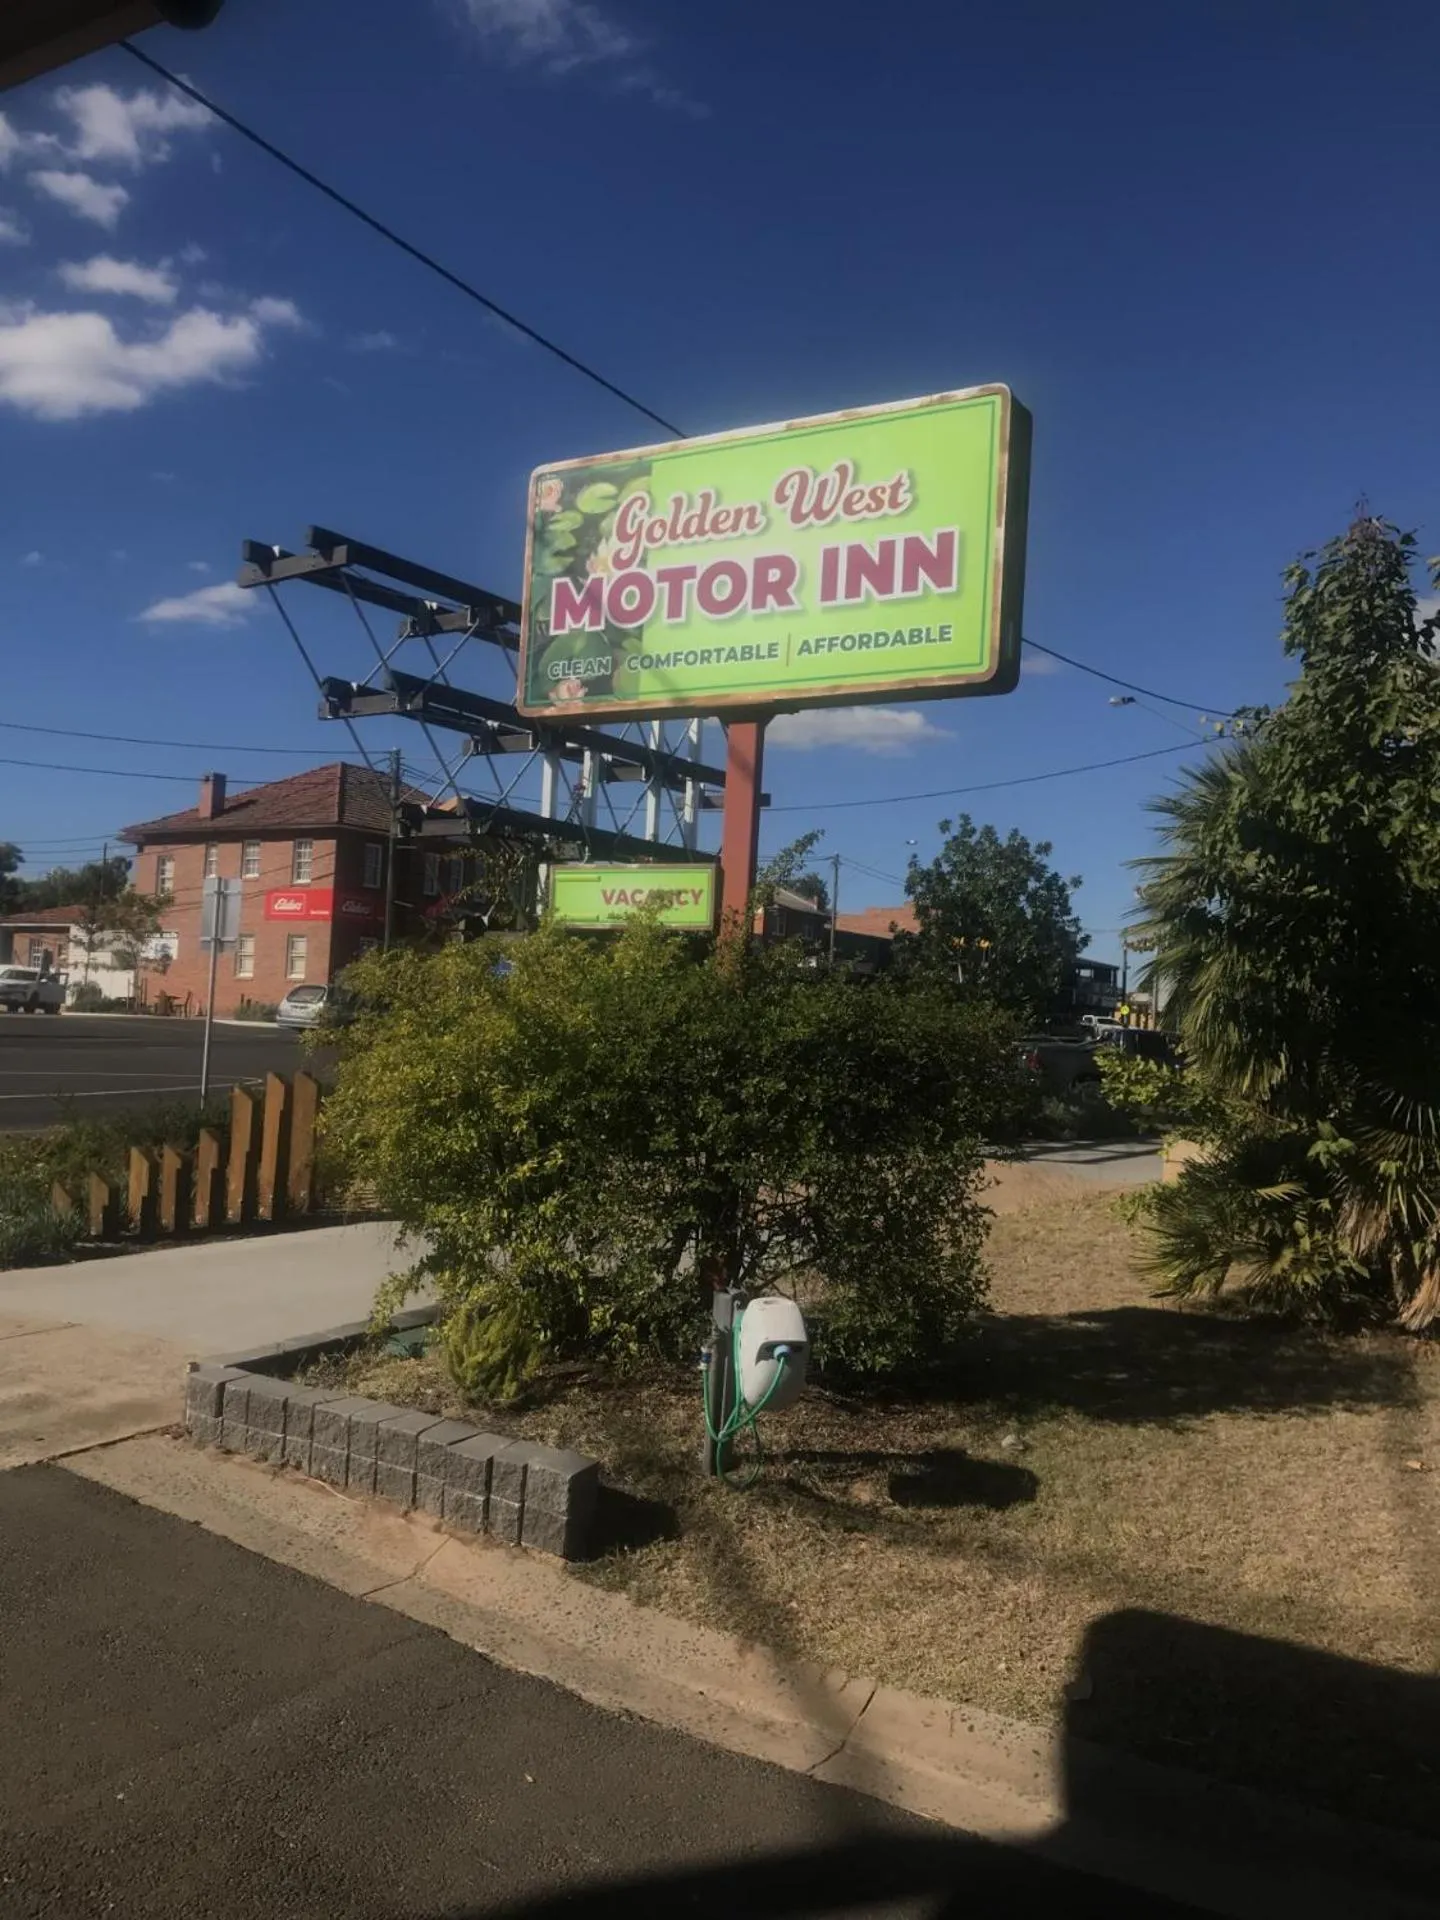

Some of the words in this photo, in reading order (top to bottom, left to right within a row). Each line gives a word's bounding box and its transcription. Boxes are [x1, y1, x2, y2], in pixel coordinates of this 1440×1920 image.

[612, 495, 762, 570] Golden
[774, 463, 910, 525] West
[552, 556, 797, 631] MOTOR
[820, 531, 956, 603] INN
[548, 656, 612, 680] CLEAN
[627, 642, 780, 672] COMFORTABLE
[796, 625, 953, 657] AFFORDABLE
[601, 888, 704, 905] VACACY
